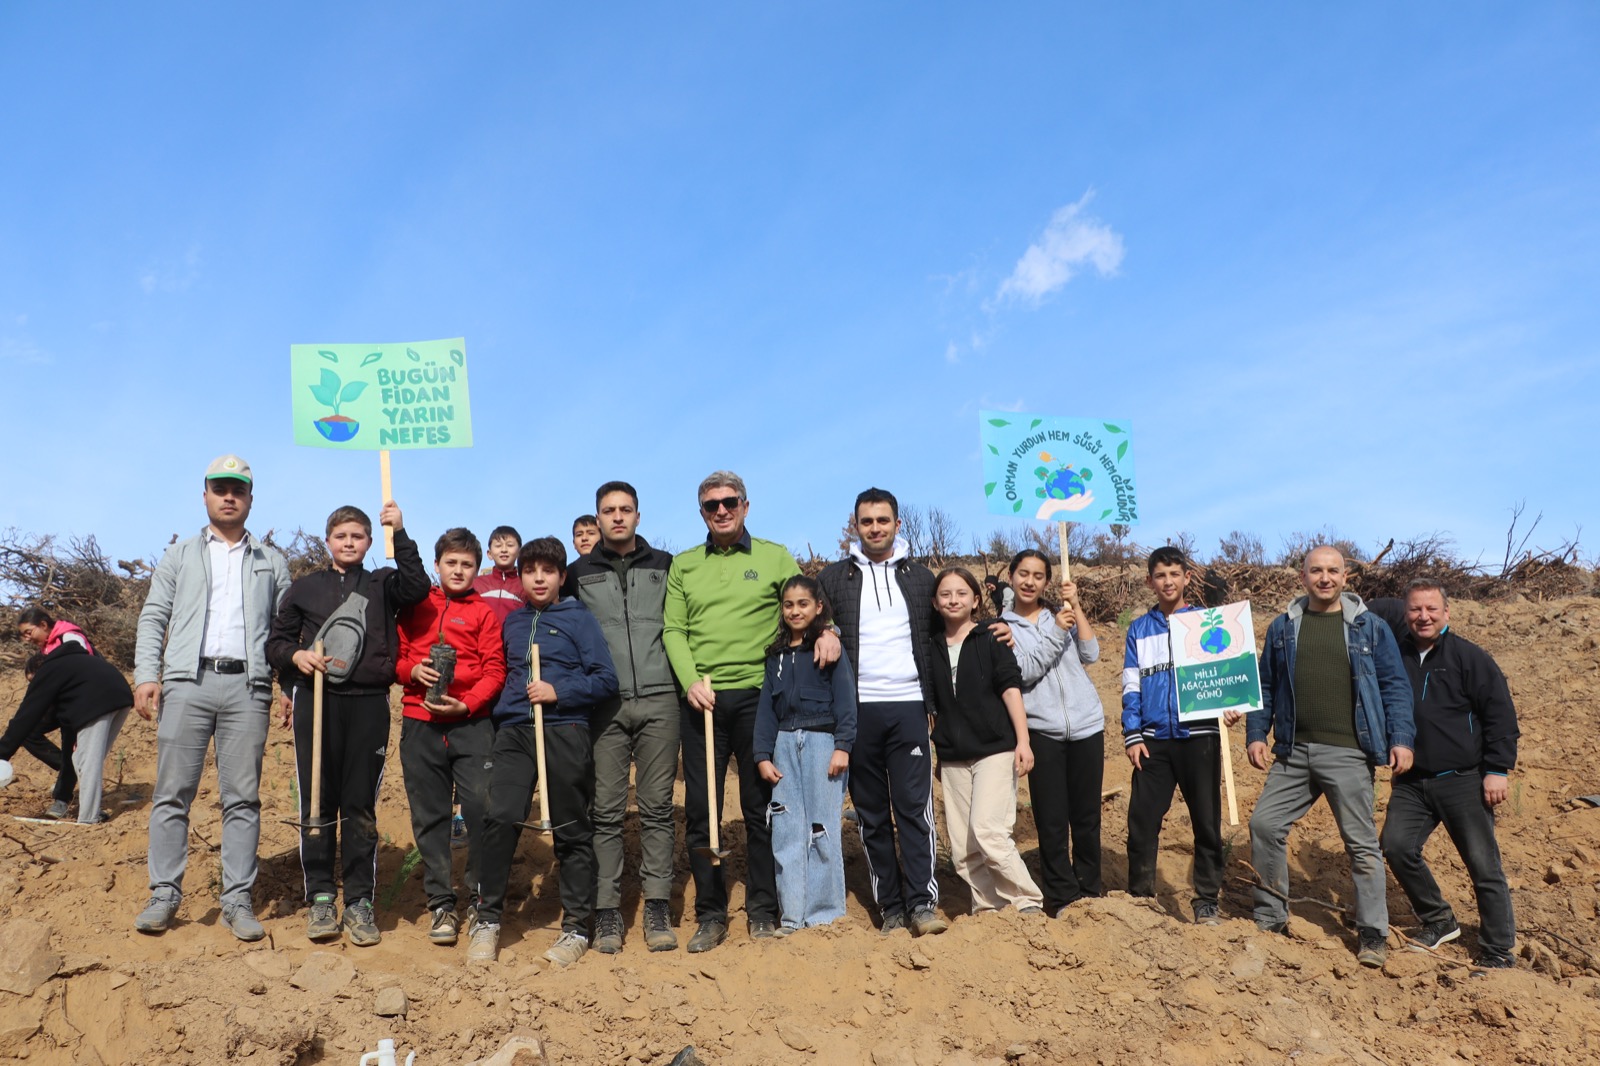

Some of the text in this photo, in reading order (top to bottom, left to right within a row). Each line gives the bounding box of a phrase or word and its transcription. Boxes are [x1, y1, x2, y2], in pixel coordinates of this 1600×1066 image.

[377, 361, 456, 386] BUGÜN
[381, 385, 450, 405] FİDAN
[382, 405, 454, 425] YARIN
[379, 425, 451, 445] NEFES
[1004, 460, 1018, 501] ORMAN
[1012, 431, 1047, 459] YURDUN
[1048, 430, 1070, 441] HEM
[1099, 454, 1117, 475] HEM
[1194, 666, 1218, 680] MİLLİ
[1196, 688, 1223, 700] GÜNÜ
